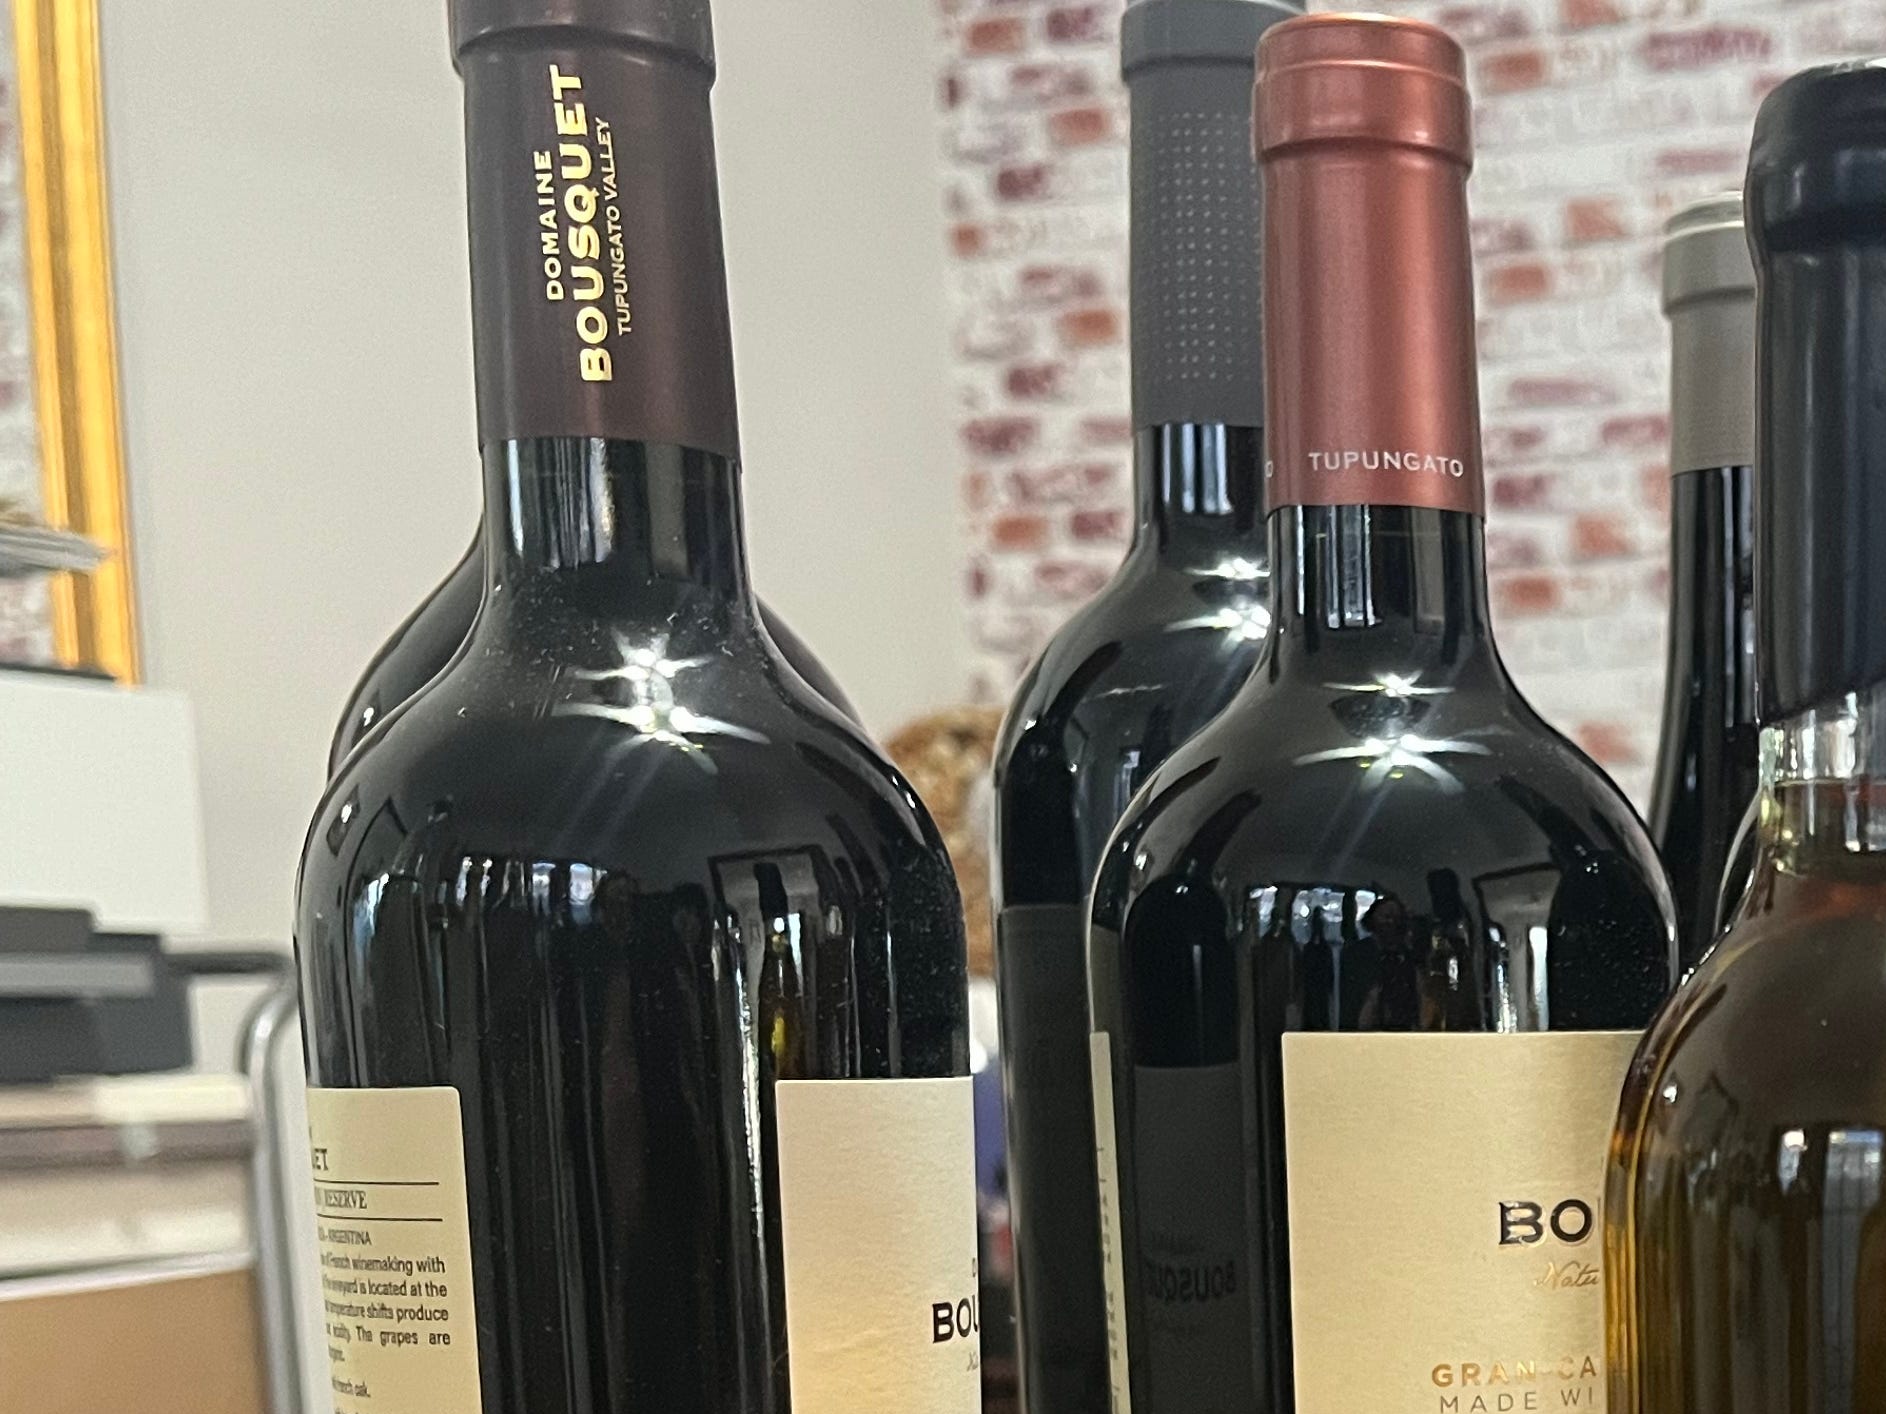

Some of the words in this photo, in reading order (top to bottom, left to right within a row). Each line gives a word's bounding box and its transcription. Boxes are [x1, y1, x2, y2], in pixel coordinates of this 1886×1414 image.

[594, 116, 618, 201] VALLEY
[534, 151, 564, 300] DOMAINE
[550, 64, 613, 381] BOUSQUET
[606, 205, 632, 336] TUPUNGATO
[1308, 451, 1464, 478] TUPUNGATO
[1498, 1198, 1594, 1246] BO
[416, 1255, 446, 1274] with
[410, 1281, 422, 1297] at
[425, 1281, 448, 1298] the
[396, 1304, 449, 1324] produce
[380, 1330, 418, 1348] grapes
[428, 1332, 451, 1346] are
[1431, 1360, 1537, 1388] GRAN
[1440, 1390, 1538, 1414] MADE
